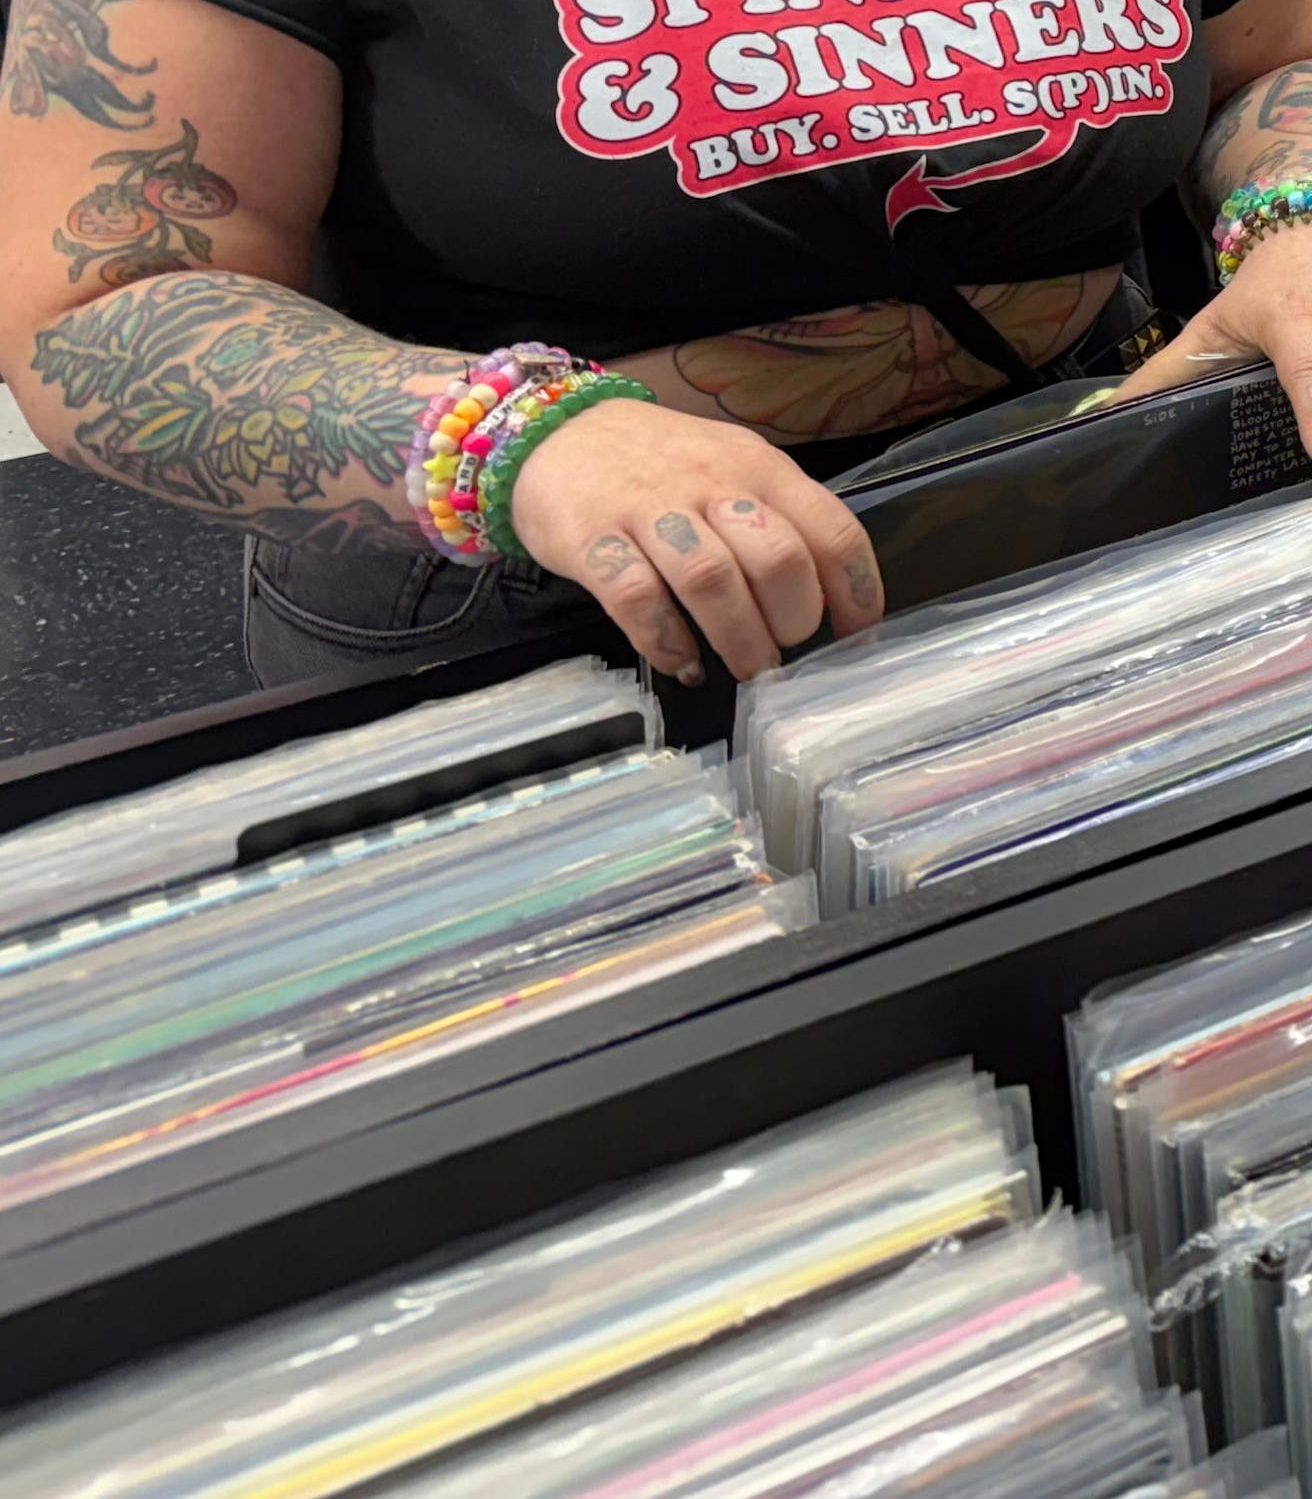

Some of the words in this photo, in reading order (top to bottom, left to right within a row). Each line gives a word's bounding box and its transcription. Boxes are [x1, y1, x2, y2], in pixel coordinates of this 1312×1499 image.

[575, 50, 681, 142] &
[688, 111, 841, 181] BUY.
[848, 92, 996, 145] SELL.
[1002, 62, 1166, 119] S(P)IN.
